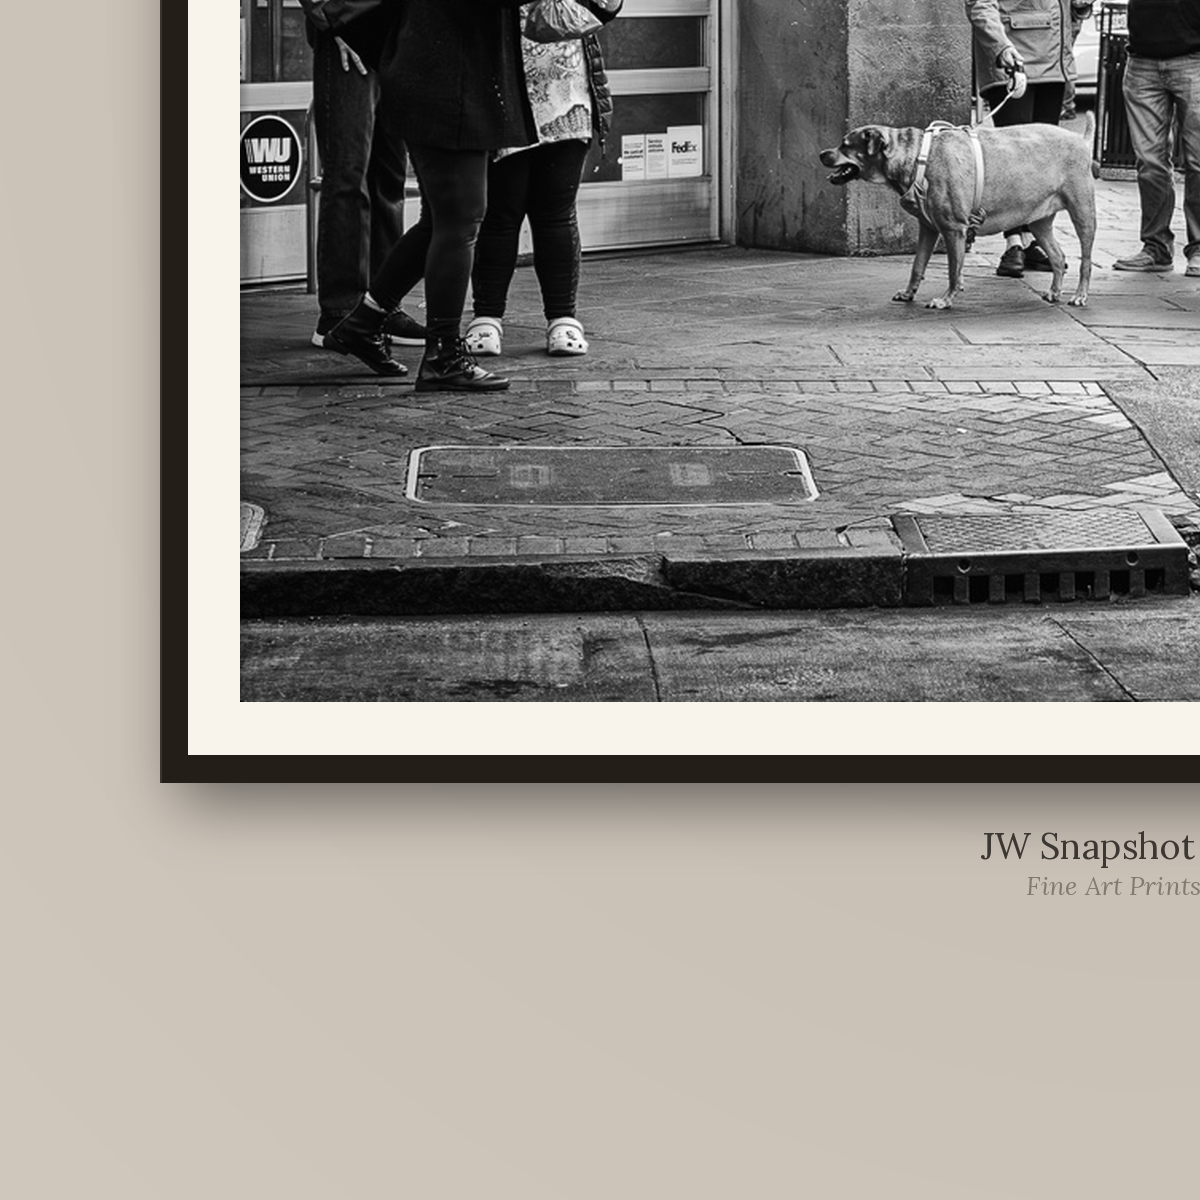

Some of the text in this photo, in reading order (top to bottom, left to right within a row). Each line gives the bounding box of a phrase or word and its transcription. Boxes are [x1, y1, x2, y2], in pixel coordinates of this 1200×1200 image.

[671, 141, 698, 154] FedEx
[249, 165, 291, 174] WESTERN
[262, 173, 291, 182] UNION
